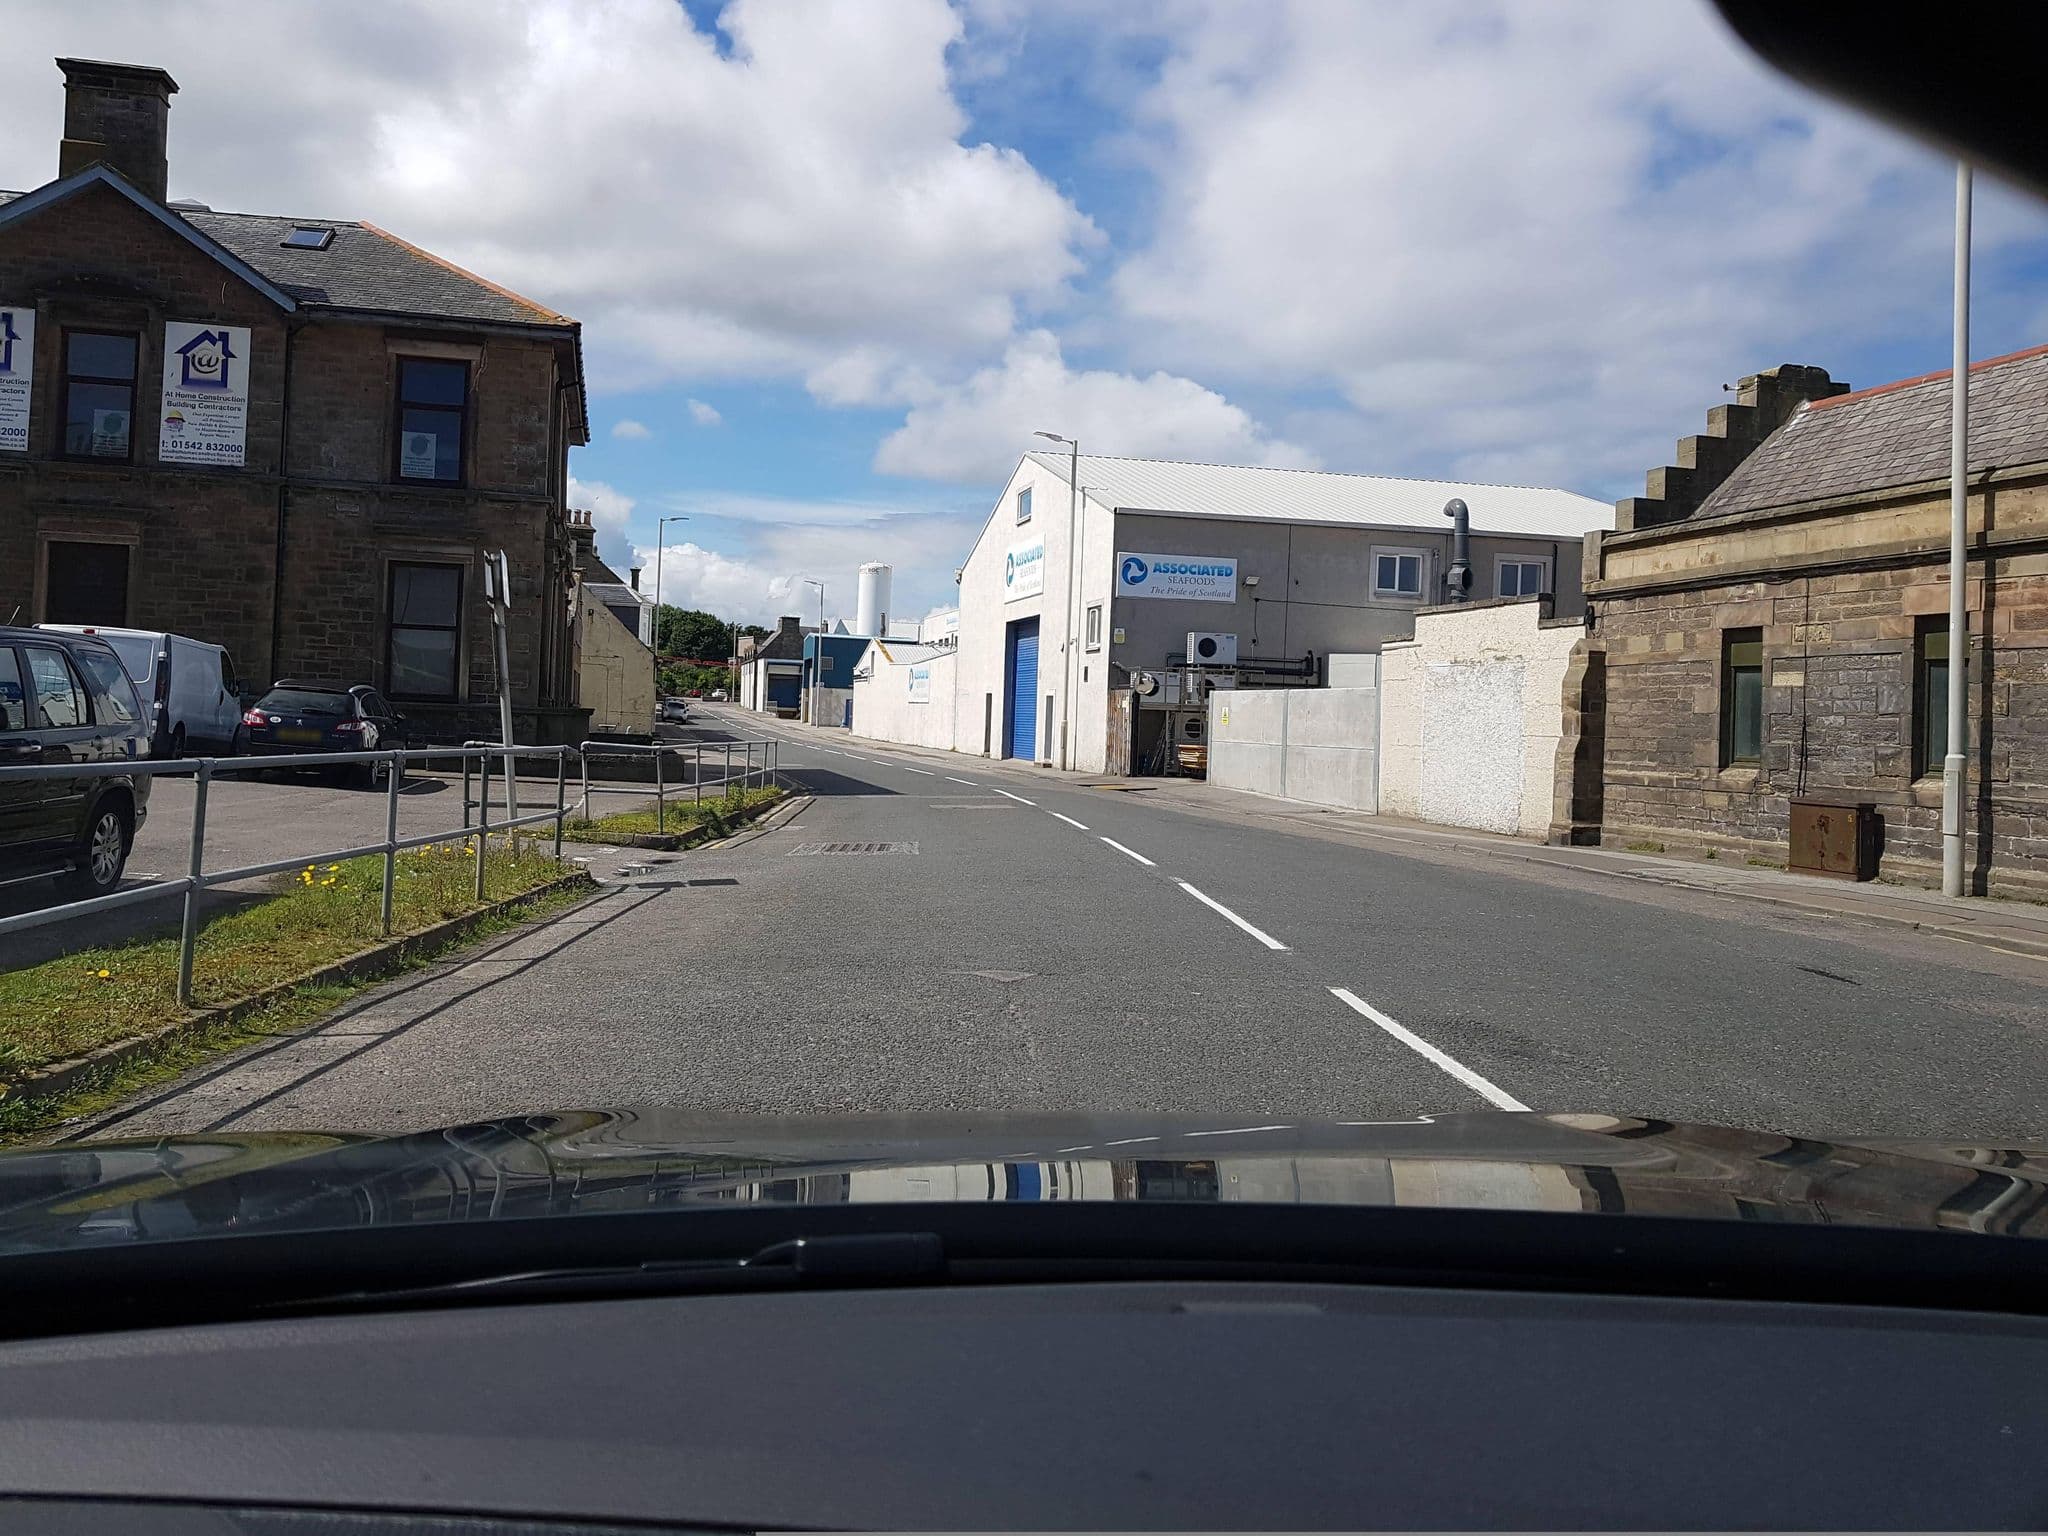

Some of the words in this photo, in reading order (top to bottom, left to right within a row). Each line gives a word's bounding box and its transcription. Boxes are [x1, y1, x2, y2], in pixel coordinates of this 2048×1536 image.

[198, 393, 246, 402] Construction
[167, 401, 197, 409] Building
[198, 402, 242, 411] Contractors
[0, 427, 26, 436] 2000
[171, 440, 203, 450] 01542
[206, 442, 243, 453] 832000
[1152, 562, 1234, 577] ASSOCIATED
[1168, 575, 1216, 586] SEAFOODS
[1150, 586, 1165, 594] The
[1167, 587, 1185, 596] Pride
[1189, 588, 1198, 597] of
[1199, 588, 1231, 598] Scotland
